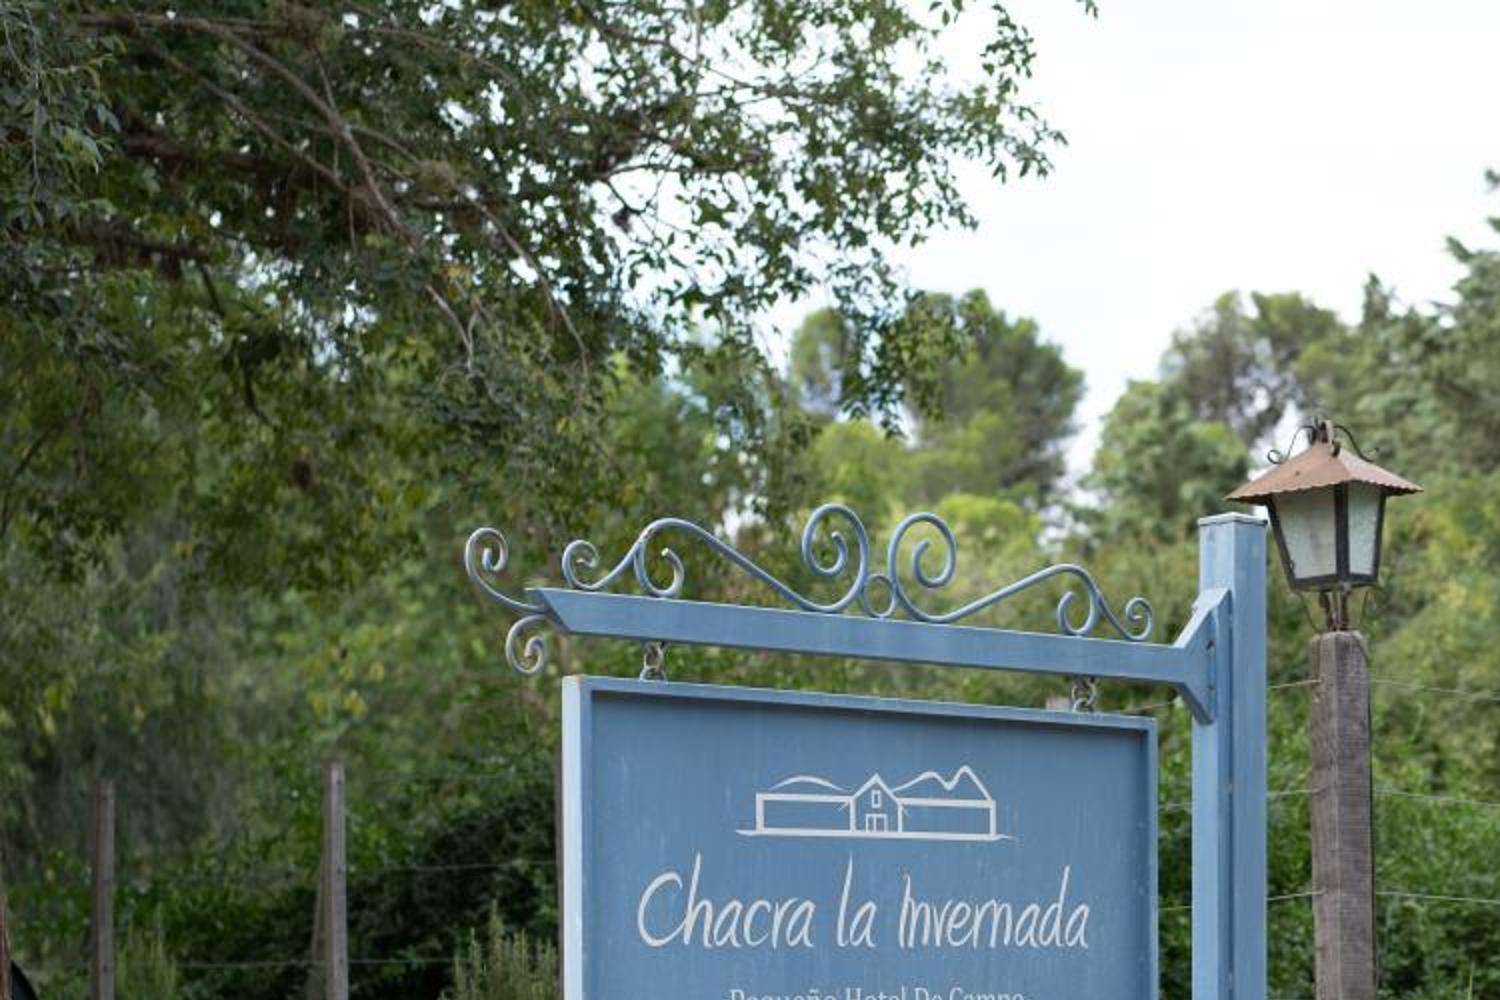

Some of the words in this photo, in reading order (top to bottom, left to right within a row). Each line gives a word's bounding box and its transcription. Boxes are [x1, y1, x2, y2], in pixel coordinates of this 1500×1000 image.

[637, 851, 817, 949] Chacra
[836, 854, 878, 949] la
[899, 864, 1091, 949] Invernada
